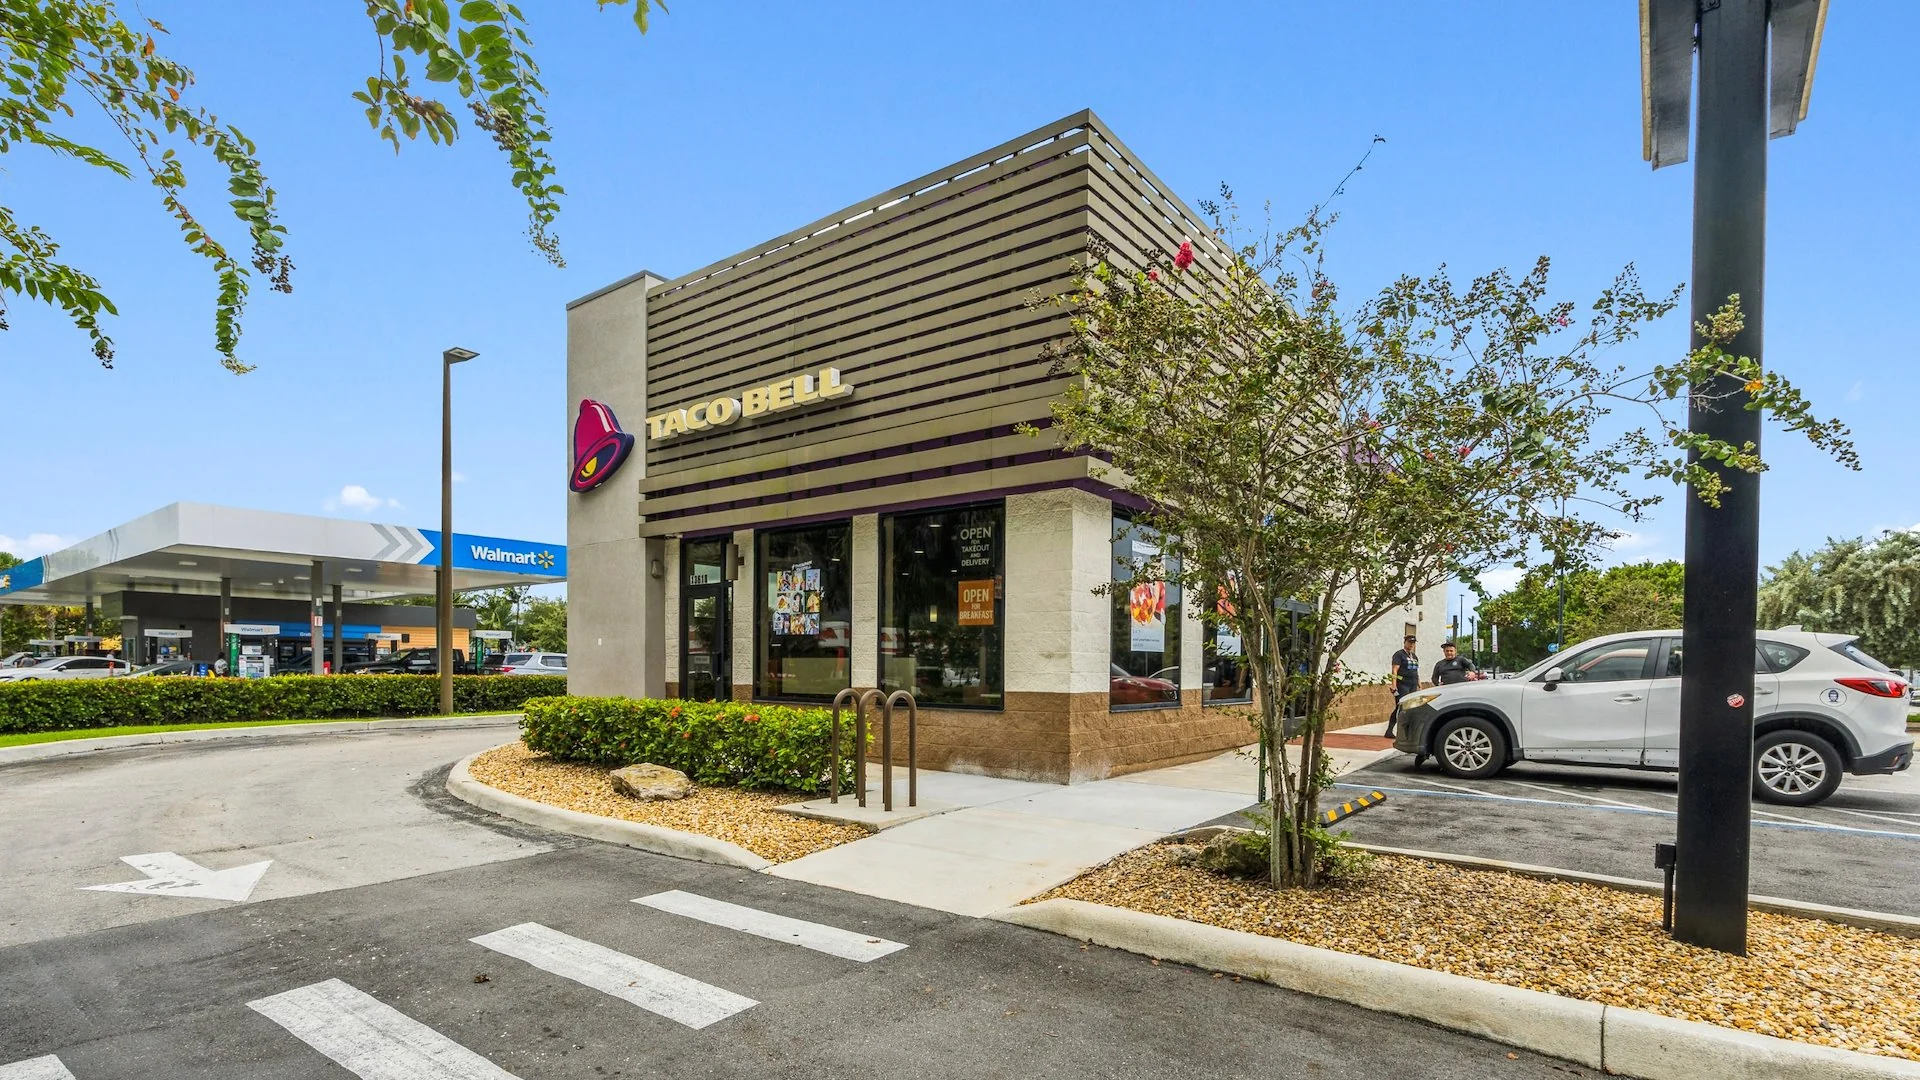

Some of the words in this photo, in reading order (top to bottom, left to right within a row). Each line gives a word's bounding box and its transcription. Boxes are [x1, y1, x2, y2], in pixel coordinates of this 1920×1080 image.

[646, 397, 740, 440] TACO
[742, 367, 852, 418] BELL
[960, 527, 991, 540] OPEN
[961, 544, 990, 552] TAKEOUT
[471, 545, 536, 565] Walmart
[961, 558, 990, 566] DELIVERY
[963, 588, 989, 602] OPEN
[960, 610, 993, 620] BREAKFAST
